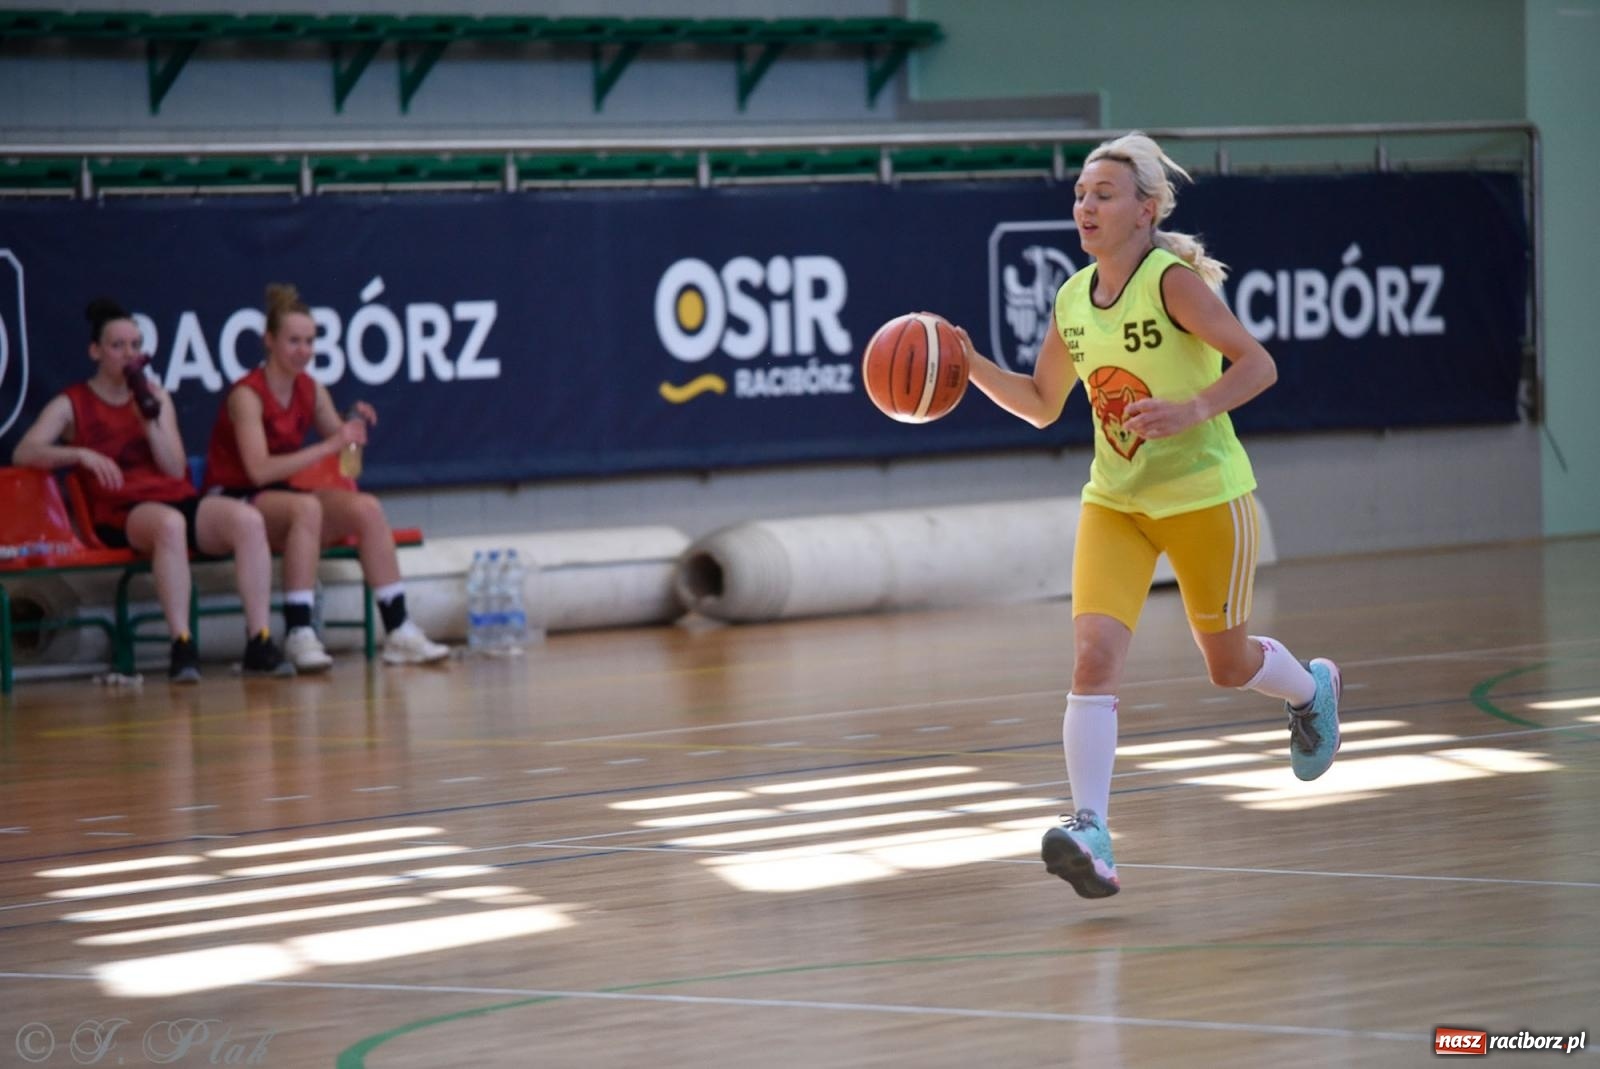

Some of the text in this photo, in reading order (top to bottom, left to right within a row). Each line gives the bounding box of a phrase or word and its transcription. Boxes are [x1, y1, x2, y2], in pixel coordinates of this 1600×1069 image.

[1222, 242, 1445, 341] CIBÓRZ
[1123, 319, 1163, 353] 55
[733, 359, 854, 398] RACIBÓRZ
